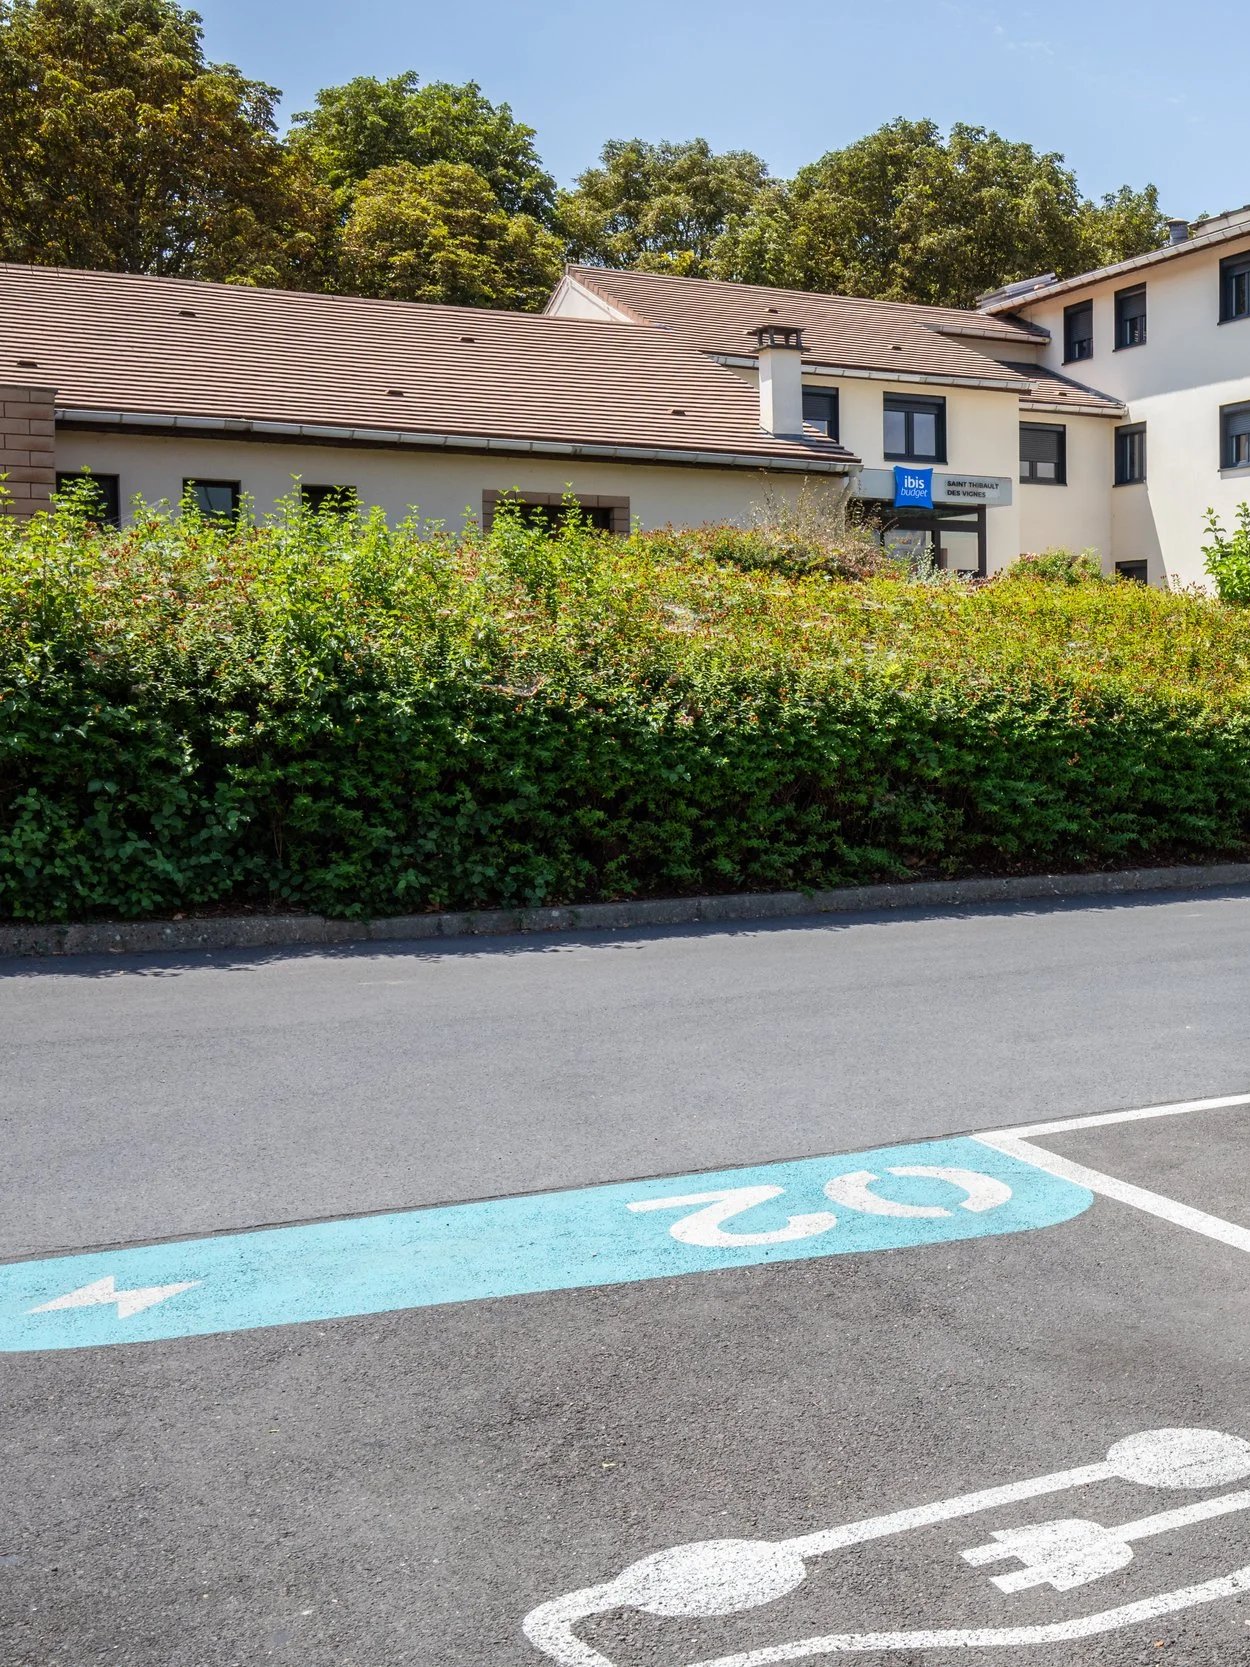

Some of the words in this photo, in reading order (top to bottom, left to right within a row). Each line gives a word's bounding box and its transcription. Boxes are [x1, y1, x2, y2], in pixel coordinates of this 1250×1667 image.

[904, 475, 925, 489] ibis
[946, 480, 967, 488] SAINT
[968, 482, 999, 490] THIBAULT
[900, 487, 928, 499] budget
[946, 489, 961, 497] DES
[962, 490, 986, 498] VIGNES
[626, 1165, 1012, 1247] 02
